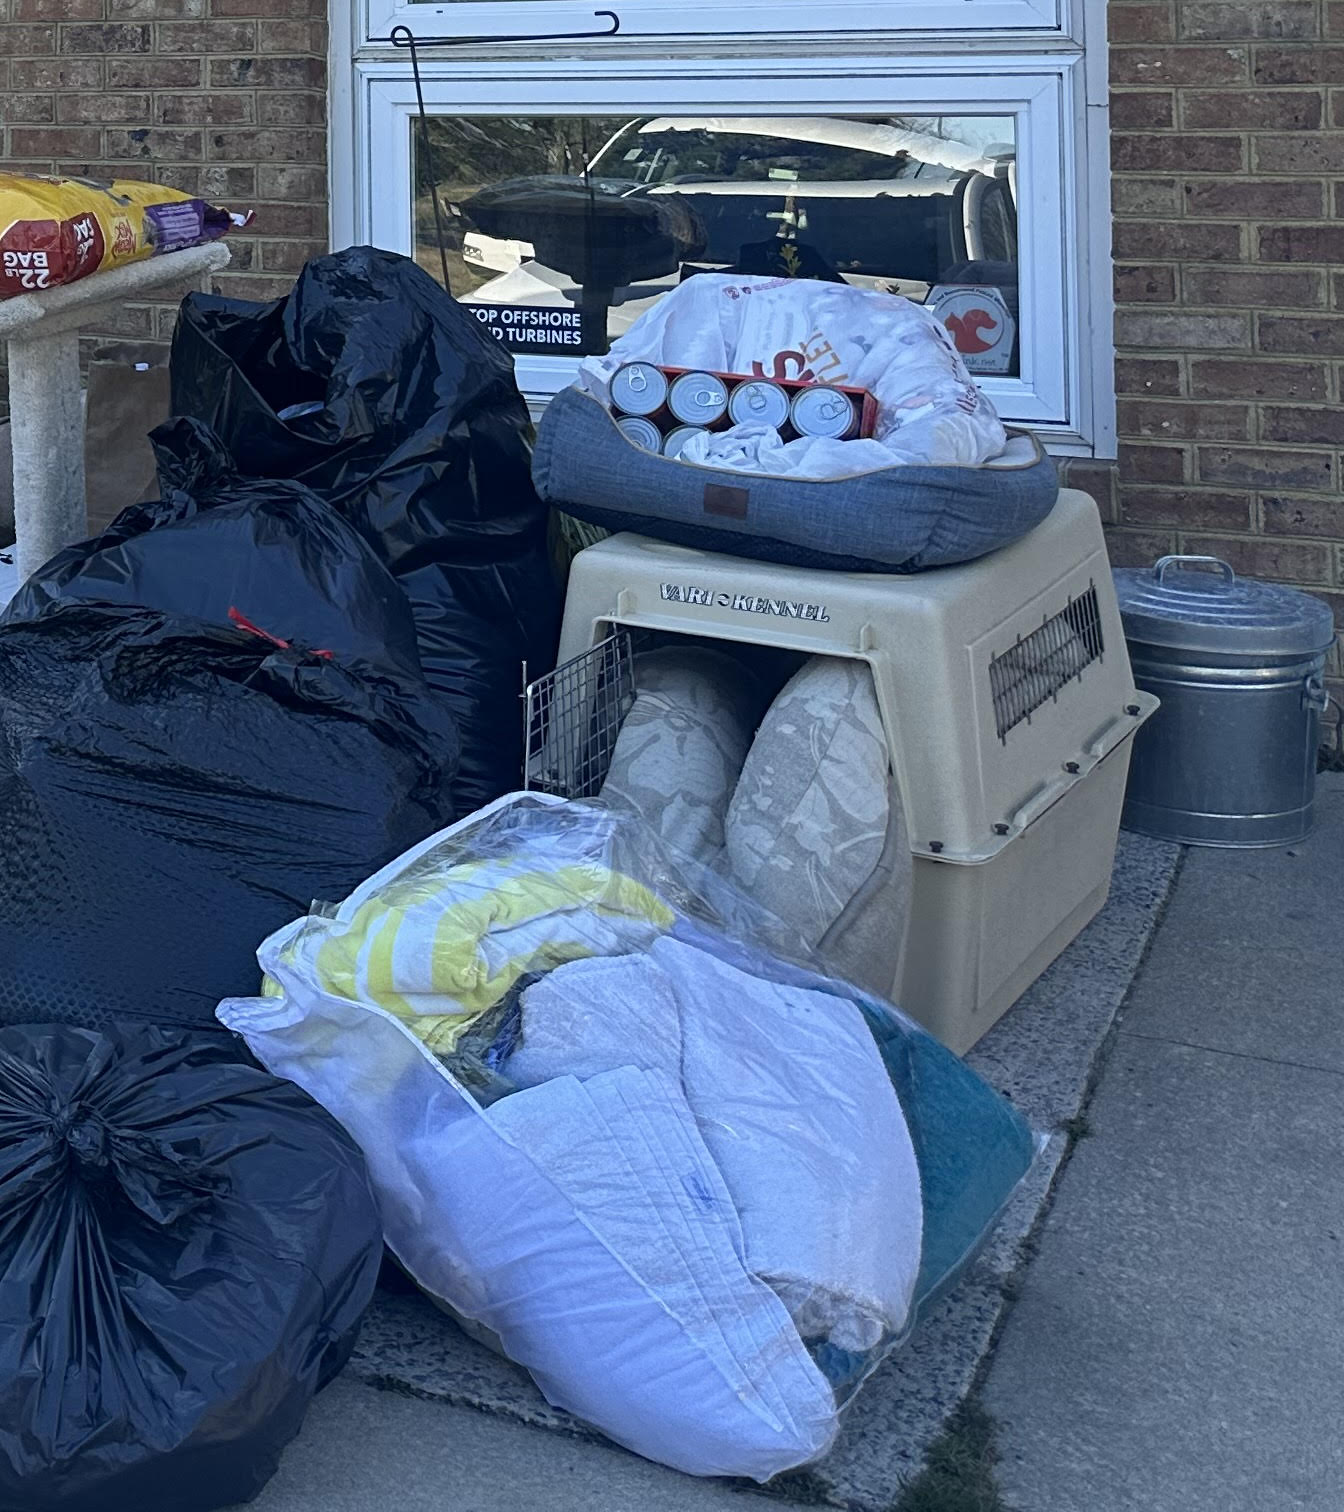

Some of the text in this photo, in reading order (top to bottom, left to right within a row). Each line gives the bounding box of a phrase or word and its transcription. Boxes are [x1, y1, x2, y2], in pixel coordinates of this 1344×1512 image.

[3, 251, 49, 268] BAG
[469, 309, 582, 327] OP OFFSHORE
[506, 327, 582, 345] TURBINES
[659, 582, 830, 623] VARI KENNEL
